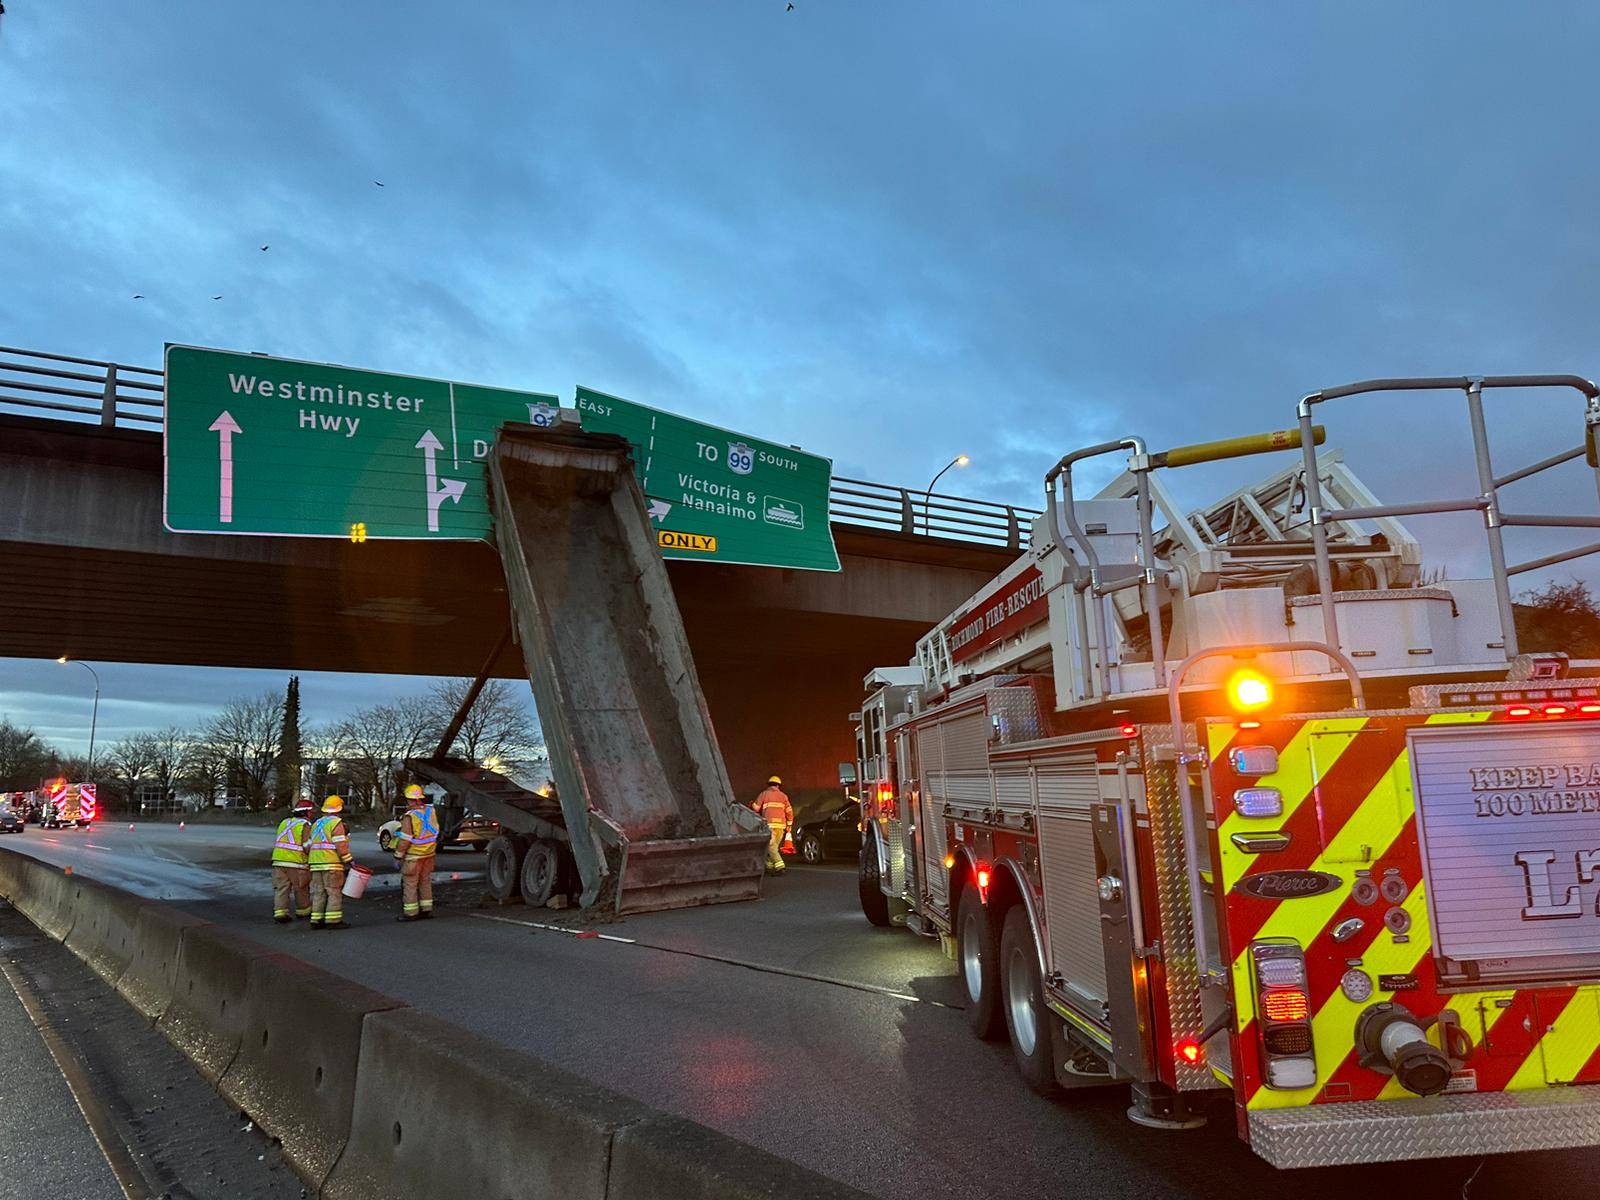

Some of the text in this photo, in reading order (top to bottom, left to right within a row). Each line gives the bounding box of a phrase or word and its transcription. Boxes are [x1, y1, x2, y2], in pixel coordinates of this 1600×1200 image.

[228, 373, 425, 413] Westminster
[579, 398, 612, 416] EAST
[299, 409, 360, 438] Hwy
[696, 442, 718, 461] TO
[730, 452, 751, 470] 99
[758, 451, 798, 471] SOUTH
[678, 473, 756, 504] Victoria &
[682, 493, 757, 520] Nanaimo
[661, 533, 713, 549] ONLY
[1469, 765, 1560, 791] KEEP
[1474, 789, 1600, 817] 100 MET
[1258, 874, 1318, 896] Pierce
